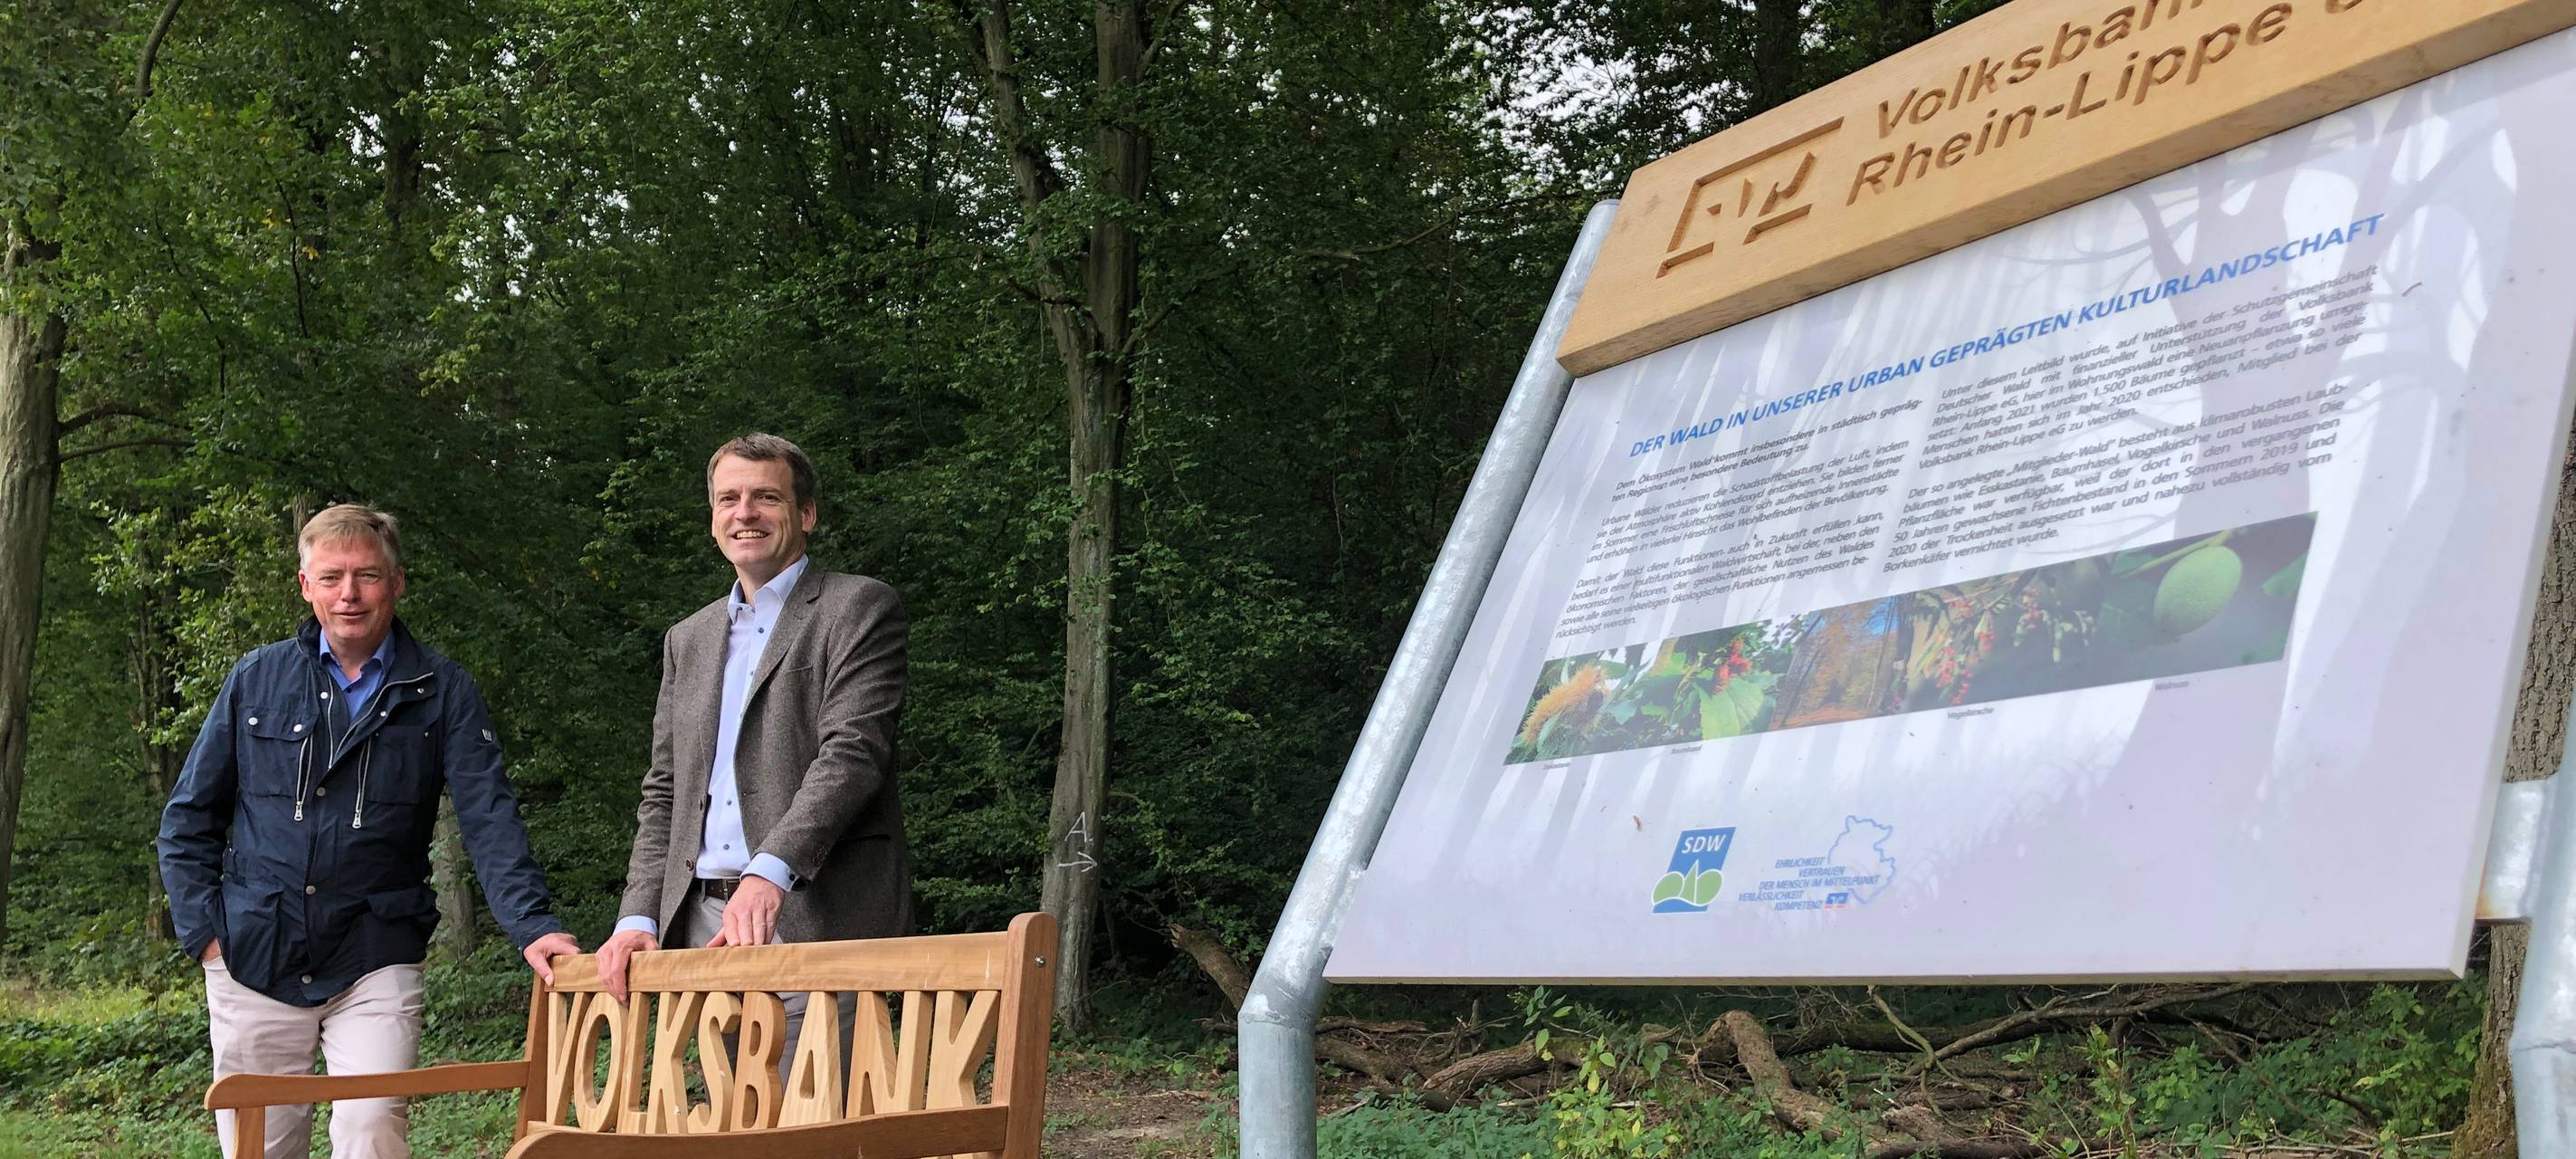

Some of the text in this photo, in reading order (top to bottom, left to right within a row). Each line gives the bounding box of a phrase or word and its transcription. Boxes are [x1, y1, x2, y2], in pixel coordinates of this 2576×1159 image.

[1846, 2, 2293, 206] Rhein-Lippe
[1877, 0, 2203, 139] Volksban
[1629, 213, 2384, 457] DER WALD IN UNSERER URBAN GEPRÄGTEN KULTURLANDSCHAFT
[1932, 403, 1998, 427] Rhein-Lippe
[2000, 396, 2019, 408] eG,
[2022, 389, 2046, 402] hier
[2048, 385, 2064, 395] im
[2068, 354, 2164, 390] Wohnungswald
[2166, 349, 2195, 362] eine
[2320, 301, 2369, 321] umge-
[1936, 391, 1993, 414] Deutscher
[2003, 378, 2032, 395] Wald
[2040, 371, 2061, 384] mit
[2072, 350, 2138, 375] finanzieller
[2258, 308, 2285, 321] der
[2298, 281, 2373, 311] Volksbank
[1942, 384, 1973, 399] Unter
[1976, 371, 2018, 389] diesem
[2021, 355, 2065, 376] Leitbild
[2069, 344, 2110, 362] wurde,
[2115, 333, 2139, 349] auf
[2142, 320, 2198, 341] Initiative
[2202, 311, 2227, 324] der
[1960, 415, 2003, 433] Anfang
[2006, 405, 2035, 420] 2021
[2040, 392, 2087, 410] wurden
[2094, 379, 2127, 396] 1.500
[2130, 369, 2176, 386] Bäume
[2180, 349, 2246, 374] gepflanzt
[2265, 333, 2303, 350] etwa
[2307, 328, 2325, 338] so
[2332, 315, 2366, 331] viele
[1616, 399, 1922, 491] Dem Ökosystem Wald kommt insbesondere in städtisch gepräg-
[1907, 487, 1930, 499] Der
[1931, 484, 1944, 493] so
[1946, 469, 2005, 490] angelegte
[2118, 427, 2169, 447] besteht
[2171, 422, 2196, 434] aus
[2305, 383, 2348, 401] Laub-
[1919, 407, 2138, 469] Volksbank Rhein-Lippe eG zu werden.
[1922, 331, 2364, 455] Menschen hatten sich im Jahr 2020 entschieden, Mitglied bei der
[1611, 443, 1809, 503] ten Regionen eine besondere Bedeutung zu.
[1737, 484, 1888, 527] Wohlbefinden der Bevölkerung.
[1775, 468, 1900, 506] aufheizende Innenstädte
[1887, 453, 2333, 558] 2020 der Trockenheit ausgesetzt war und nahezu vollständig vom
[1893, 531, 1909, 542] 50
[1912, 523, 1950, 539] Jahren
[1953, 506, 2027, 532] gewachsene
[2133, 479, 2146, 488] in
[2151, 472, 2180, 484] den
[2185, 455, 2254, 477] Sommern
[2259, 442, 2299, 460] 2019
[2304, 432, 2337, 449] und
[1898, 418, 2341, 528] Pflanzfläche war verfügbar, weil der dort in den vergangenen
[1903, 400, 2345, 513] bäumen wie Esskastanie, Baumhasel, Vogelkirsche und Walnuss. Die
[1883, 528, 2059, 572] Borkenkäfer vernichtet wurde.
[1681, 833, 1728, 854] SDW
[1759, 875, 1881, 890] DER MENSCH IM MITTELPUNKT
[1775, 857, 1826, 868] EHRLICHKEIT
[1798, 867, 1846, 877] VERTRAUEN
[1774, 899, 1823, 911] KOMPETENZ
[546, 991, 1000, 1134] VOLKSBANK
